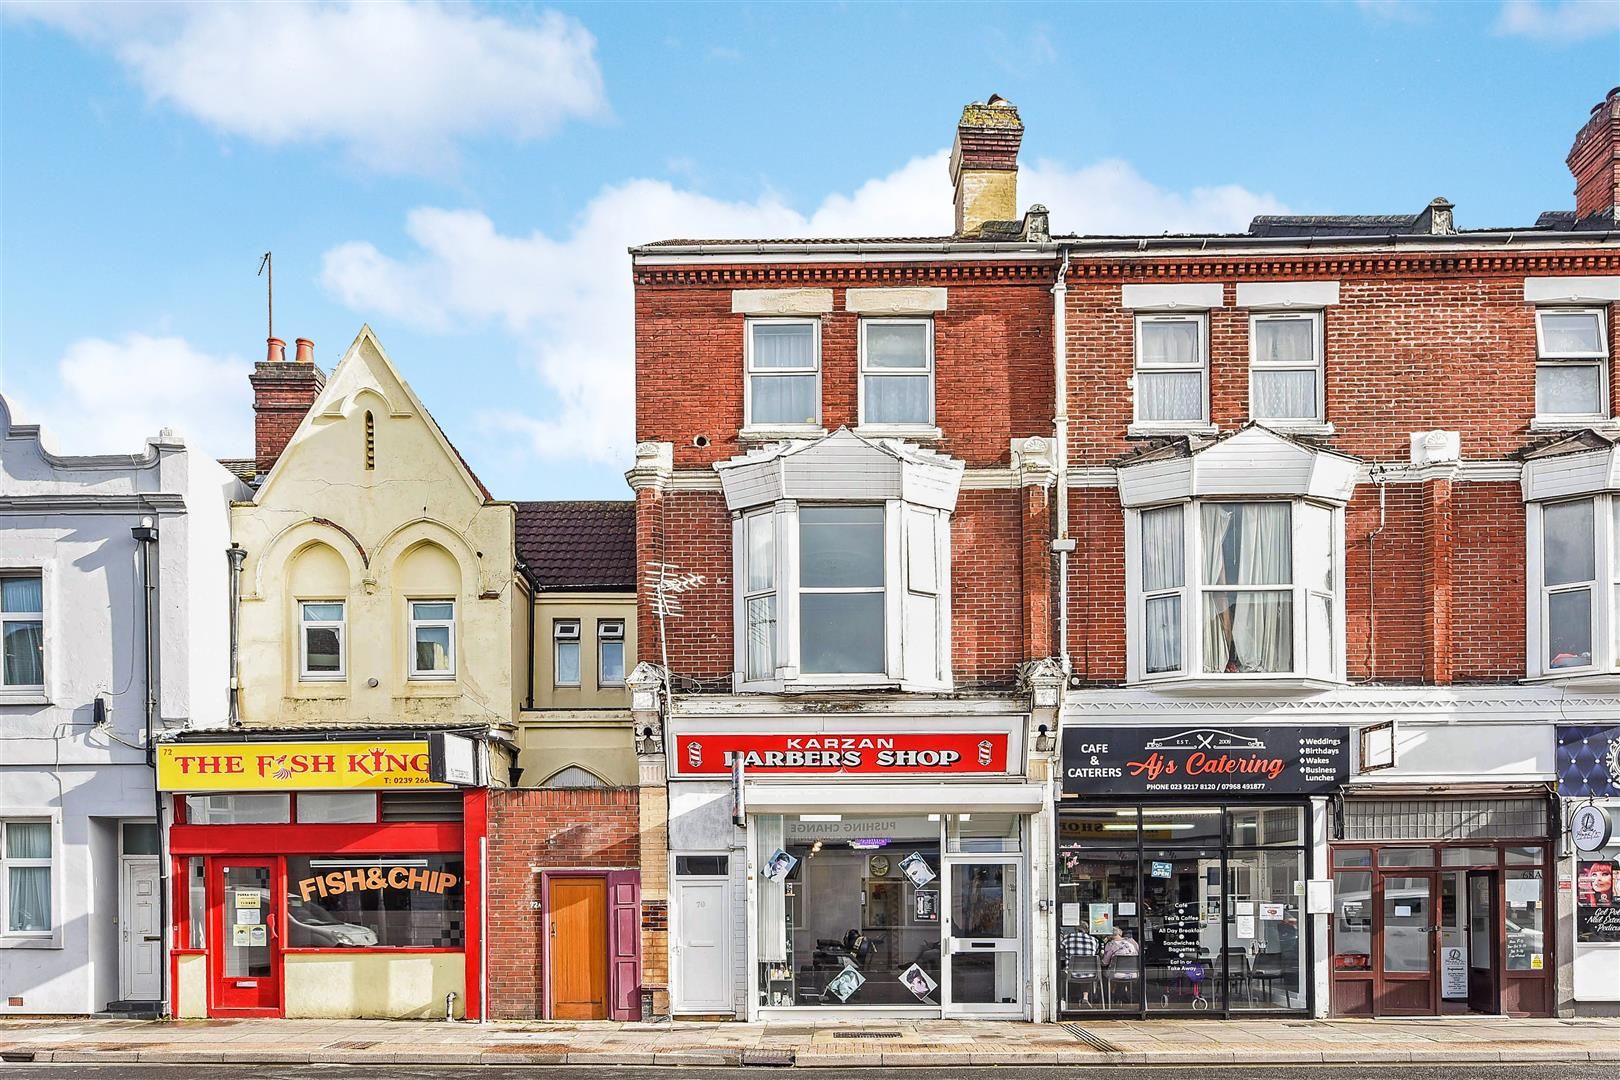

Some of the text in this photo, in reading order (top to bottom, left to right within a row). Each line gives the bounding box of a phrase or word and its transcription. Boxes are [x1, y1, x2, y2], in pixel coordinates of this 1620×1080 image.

[787, 738, 894, 749] KARZAN
[1305, 738, 1341, 746] Weddings
[1081, 744, 1109, 754] CAFE
[1305, 747, 1340, 755] Birthdays
[174, 755, 245, 774] THE
[347, 748, 431, 777] KING
[876, 750, 960, 766] SHOP
[1090, 755, 1100, 765] &
[1306, 757, 1330, 765] Wakes
[1185, 752, 1286, 779] Catering
[1305, 766, 1337, 774] Business
[1067, 767, 1122, 778] CATERERS
[1305, 774, 1335, 782] Lunches
[299, 867, 457, 902] FISH&CHIP
